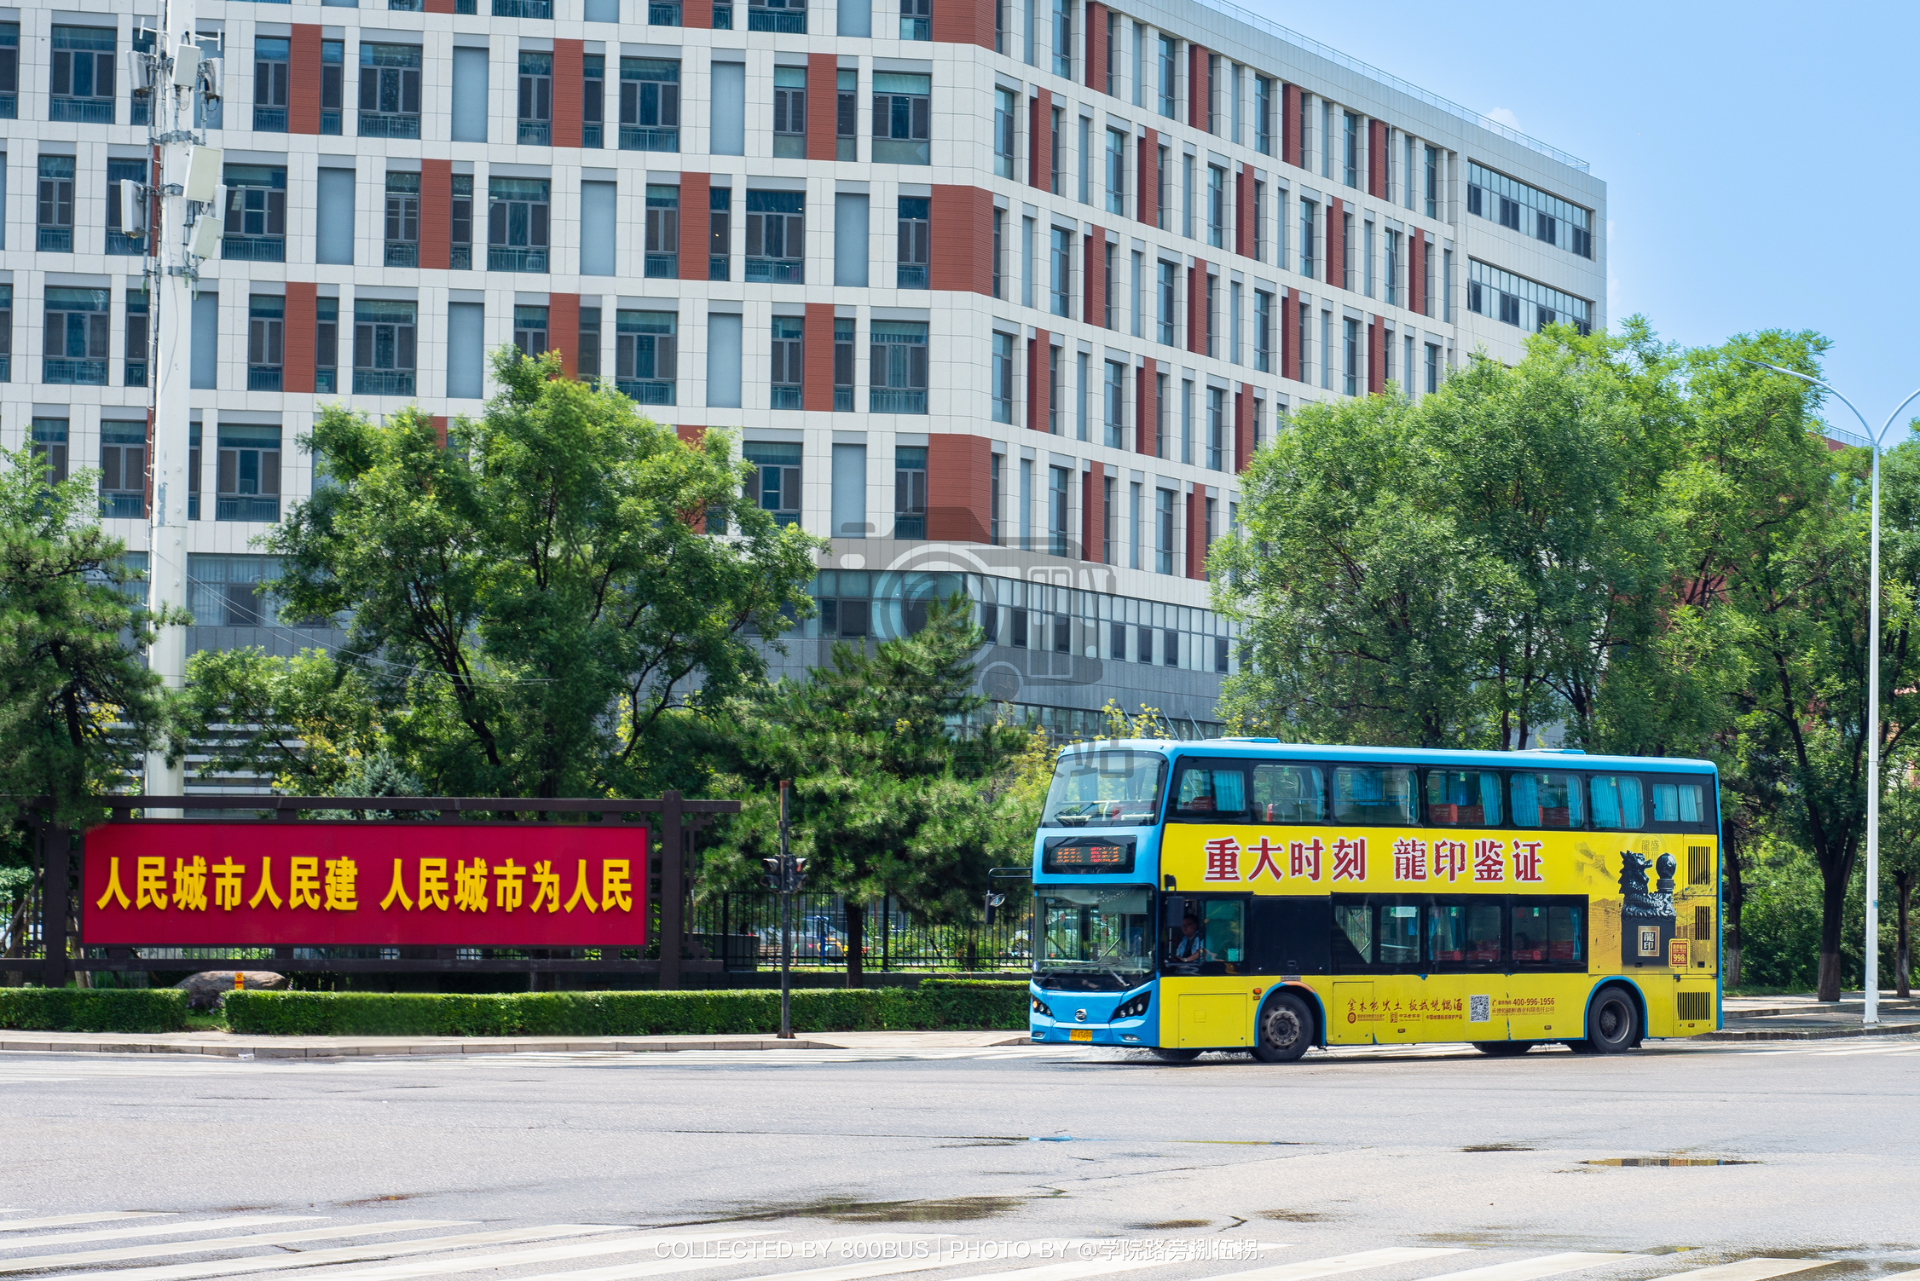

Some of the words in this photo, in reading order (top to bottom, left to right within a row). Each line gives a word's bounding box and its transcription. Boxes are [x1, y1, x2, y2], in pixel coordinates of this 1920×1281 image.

[1204, 838, 1366, 882] 重大时刻
[1393, 839, 1543, 882] 龍印鉴证
[97, 855, 358, 911] 人民城市人民建
[380, 857, 632, 913] 人民城市为人民
[1512, 997, 1555, 1006] 400-996-1956
